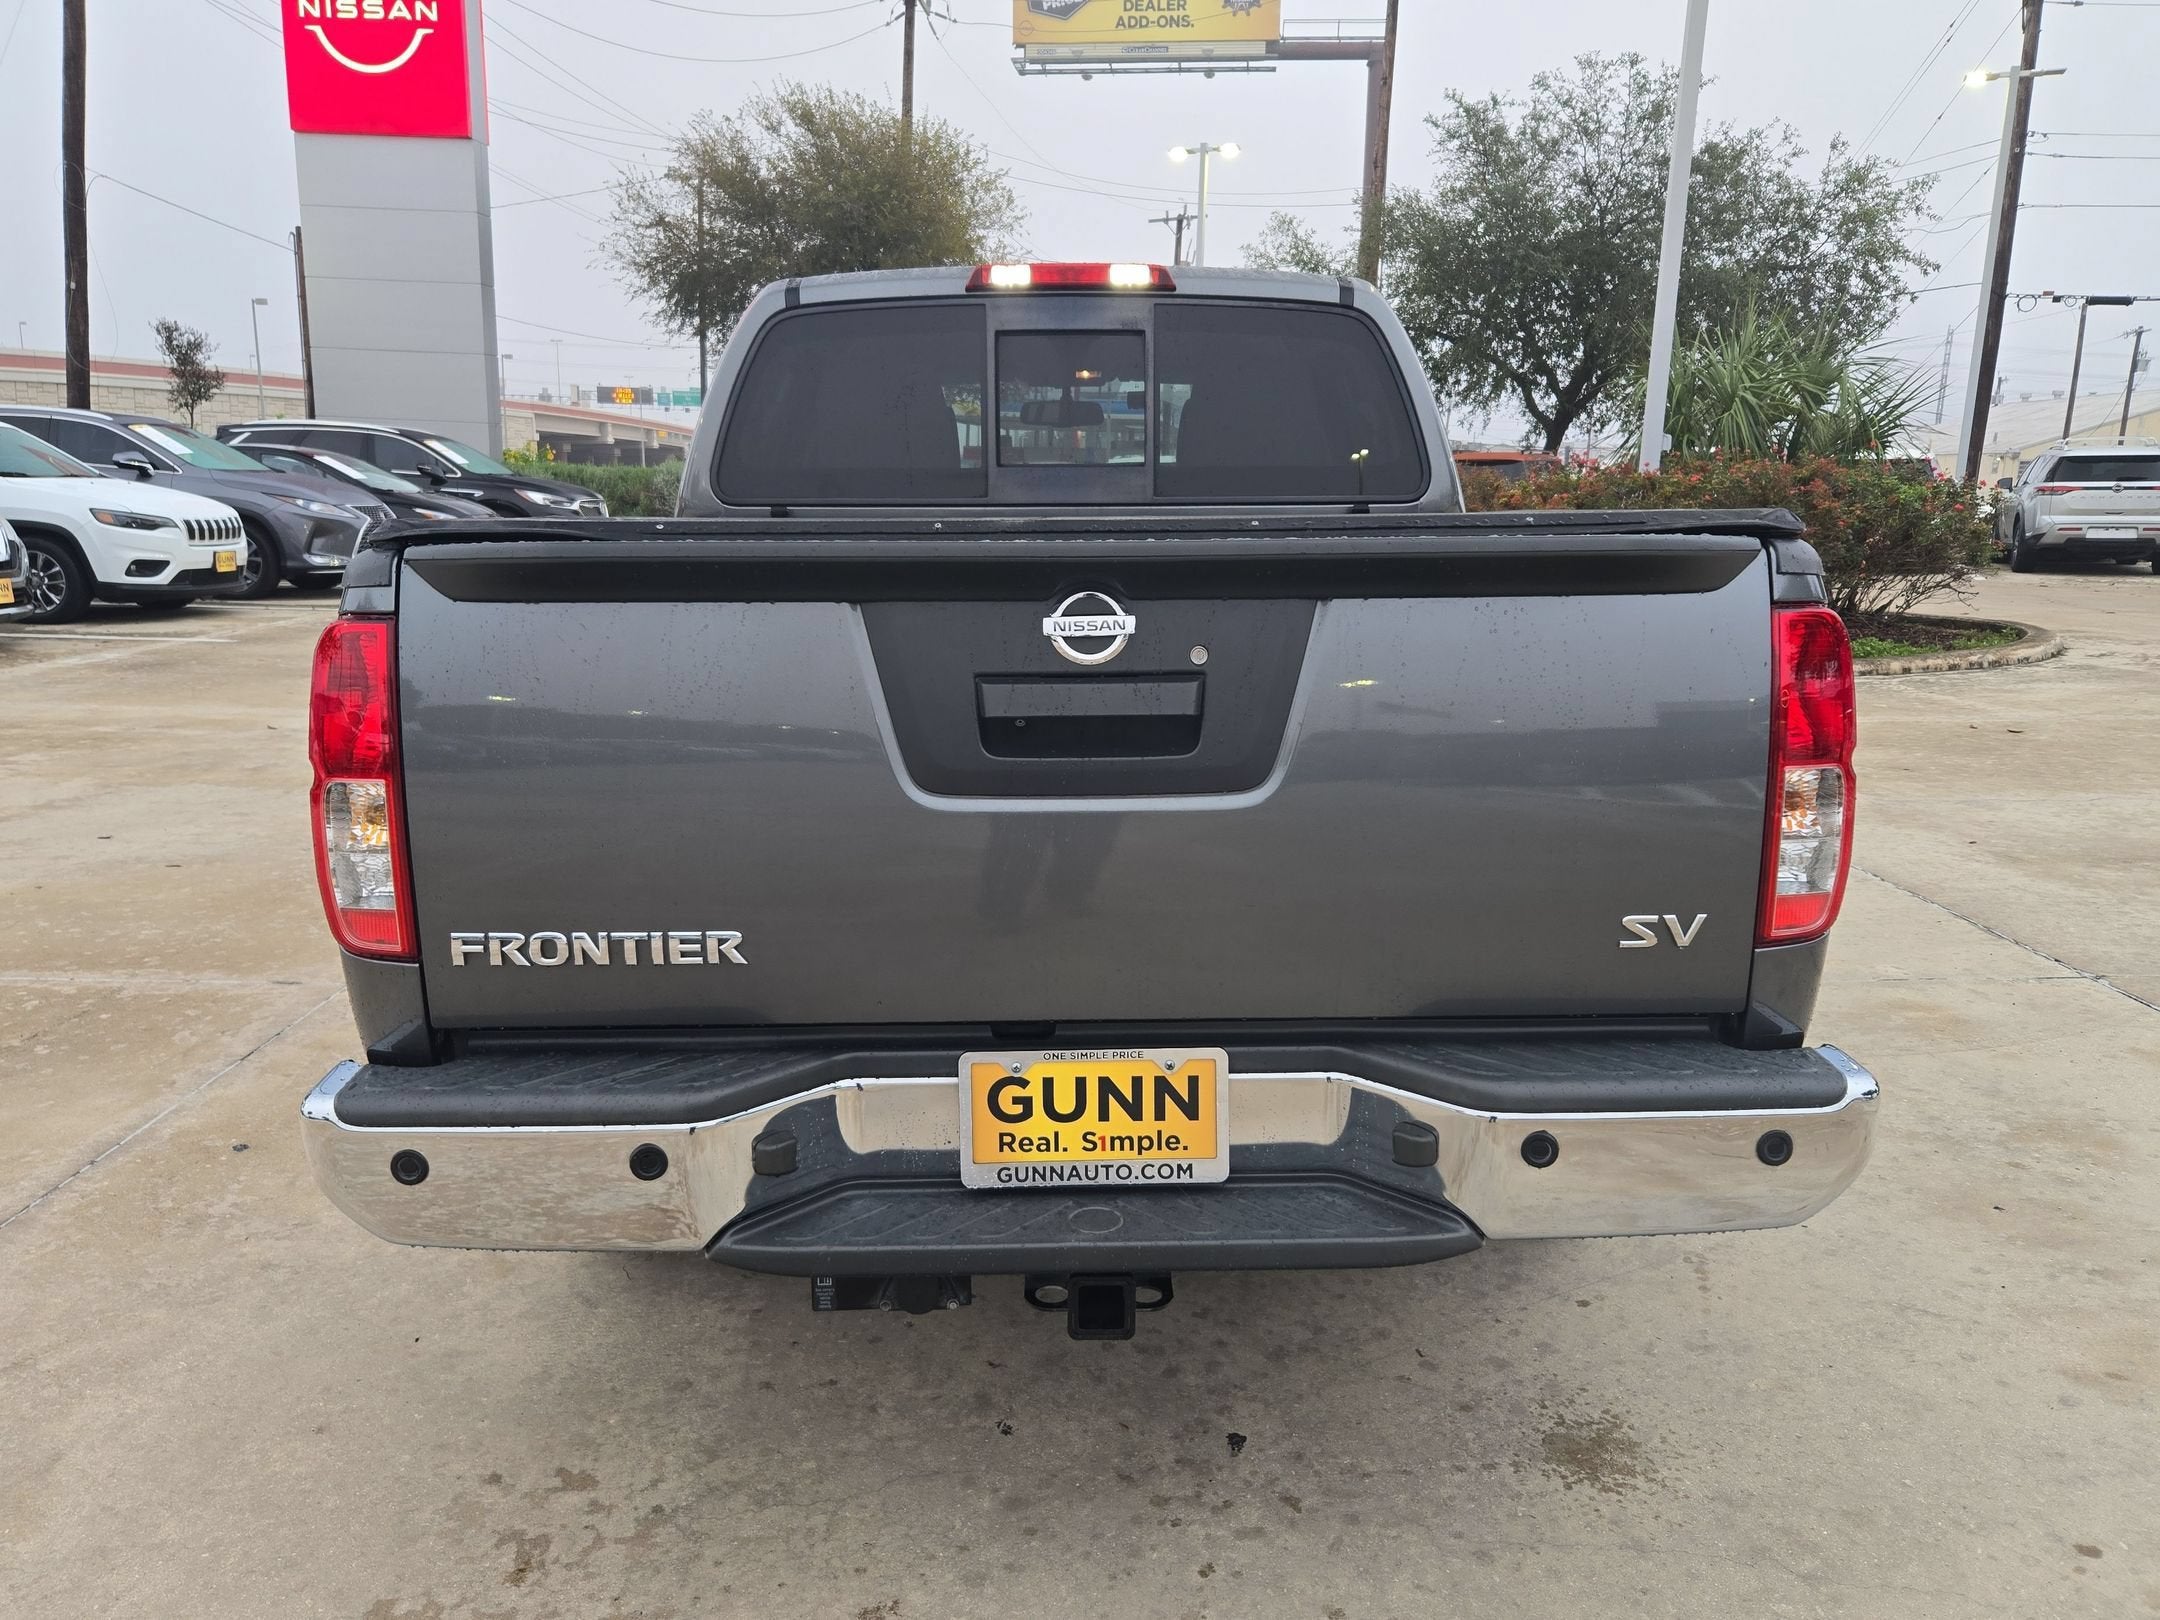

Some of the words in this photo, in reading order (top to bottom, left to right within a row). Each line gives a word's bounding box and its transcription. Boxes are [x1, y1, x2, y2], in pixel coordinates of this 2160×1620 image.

[298, 0, 438, 21] NISSAN
[1123, 0, 1187, 12] DEALER
[1115, 15, 1195, 28] ADD-ONS.
[1053, 620, 1126, 632] NISSAN
[1619, 914, 1708, 948] SV
[450, 931, 748, 966] FRONTIER
[1043, 1052, 1066, 1060] ONE
[1070, 1051, 1109, 1060] SIMPLE
[1112, 1050, 1144, 1059] PRICE
[987, 1075, 1200, 1123] GUNN
[998, 1131, 1068, 1153] Real.
[997, 1163, 1193, 1183] GUNNAUTO.COM
